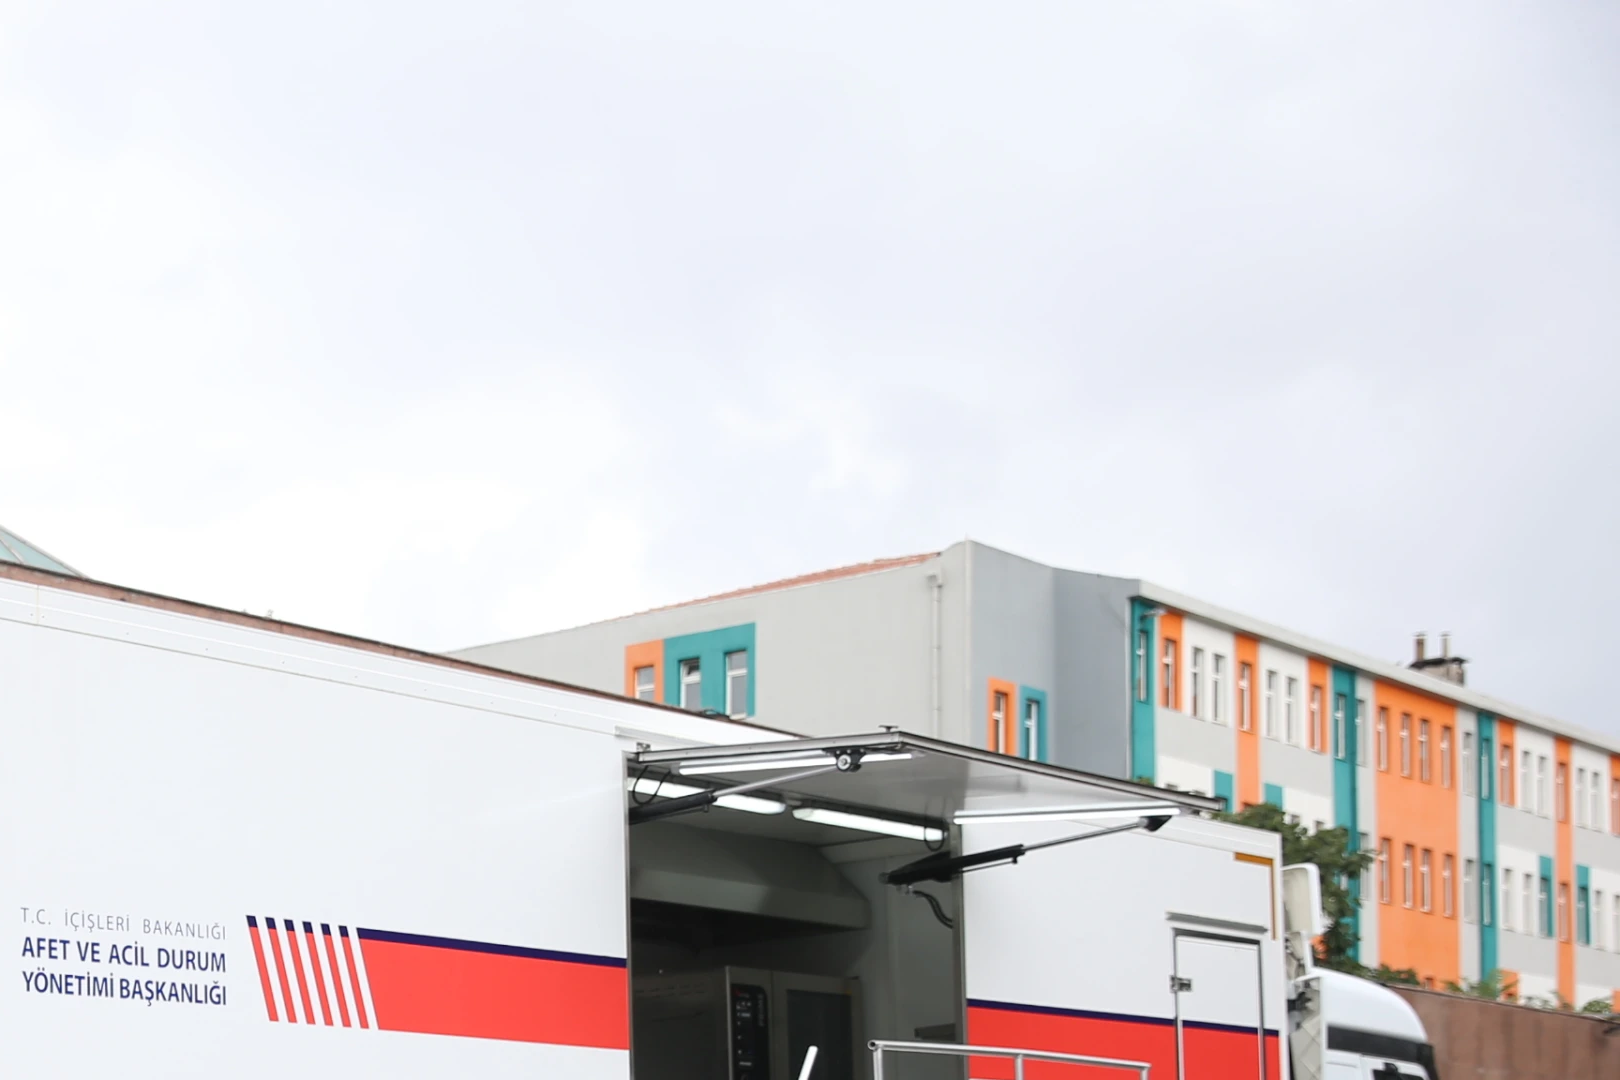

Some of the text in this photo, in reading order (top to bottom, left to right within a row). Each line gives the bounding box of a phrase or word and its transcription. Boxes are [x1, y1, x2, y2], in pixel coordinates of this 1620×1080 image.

[20, 907, 226, 940] T.C. İÇİŞLERİ BAKANLIĞI
[21, 936, 226, 972] AFET VE ACİL DURUM
[21, 966, 227, 1007] YÖNETİMİ BAŞKANLIĞI
